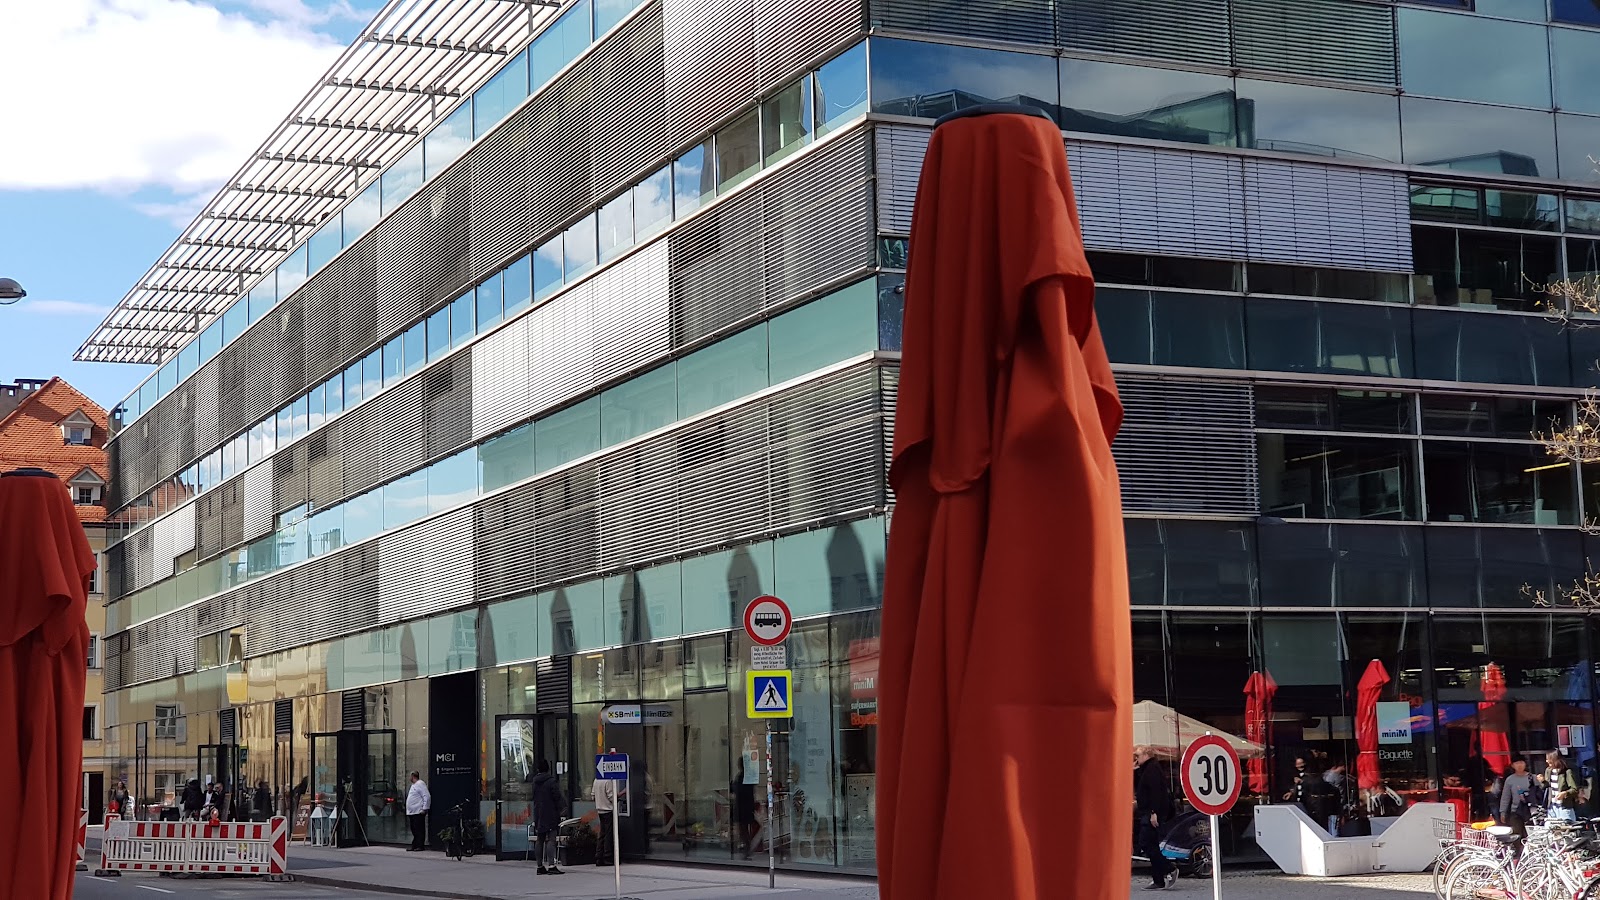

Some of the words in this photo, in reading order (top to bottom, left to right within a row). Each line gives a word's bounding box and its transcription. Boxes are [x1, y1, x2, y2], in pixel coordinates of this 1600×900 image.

[1381, 729, 1408, 738] miniM
[436, 753, 456, 762] MCI
[1378, 749, 1414, 762] Baguette
[602, 762, 623, 772] EINBAHN
[1197, 755, 1229, 796] 30
